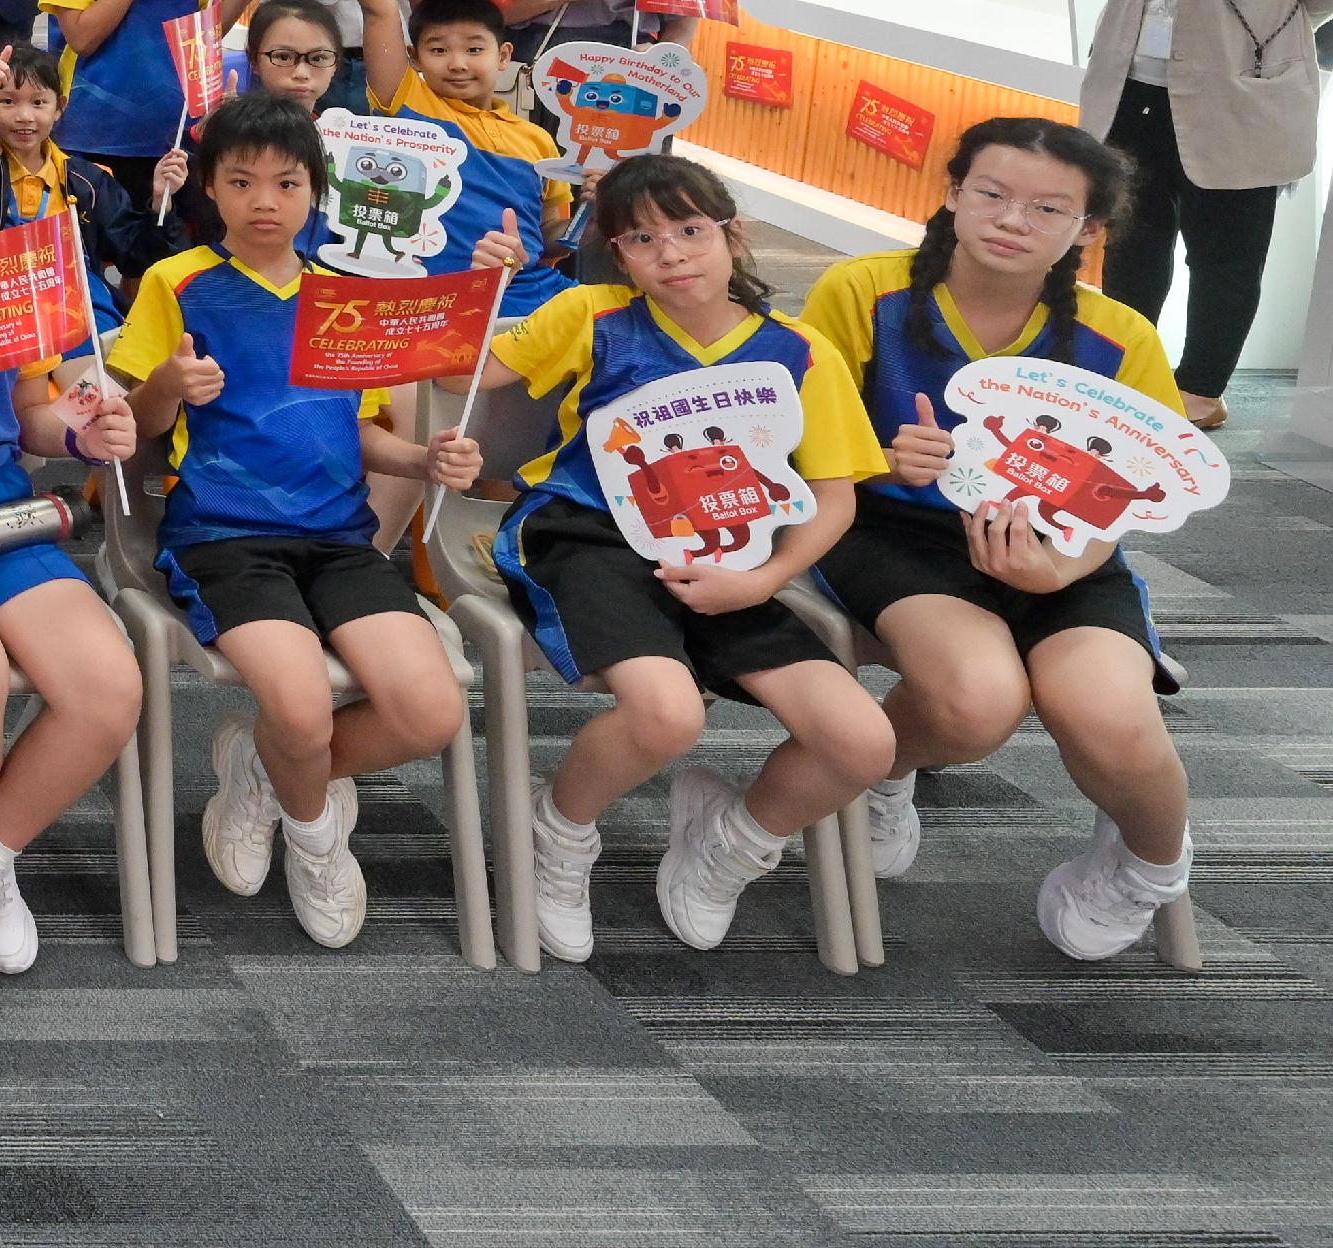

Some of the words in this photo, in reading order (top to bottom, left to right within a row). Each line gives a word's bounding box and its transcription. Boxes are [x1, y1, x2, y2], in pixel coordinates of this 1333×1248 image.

[580, 53, 615, 64] Happy
[619, 57, 667, 77] Birthday
[670, 74, 681, 84] to
[683, 82, 700, 98] Our
[628, 70, 688, 102] Motherland
[323, 128, 341, 138] the
[396, 138, 457, 155] Prosperity
[383, 125, 438, 140] Celebrate
[353, 204, 399, 225] 投票箱
[314, 300, 370, 336] 75
[374, 293, 458, 316] 熱烈慶祝
[309, 338, 410, 351] CELEBRATING
[633, 386, 778, 429] 祝祖國生日快樂
[1075, 382, 1164, 432] Celebrate
[980, 378, 1011, 392] the
[1105, 415, 1201, 496] Anniversary
[1004, 452, 1071, 494] 投票箱
[1006, 468, 1035, 487] Ballot
[1033, 481, 1054, 496] Box
[698, 486, 760, 514] 投票箱
[712, 510, 738, 521] Ballot
[739, 507, 758, 516] Box
